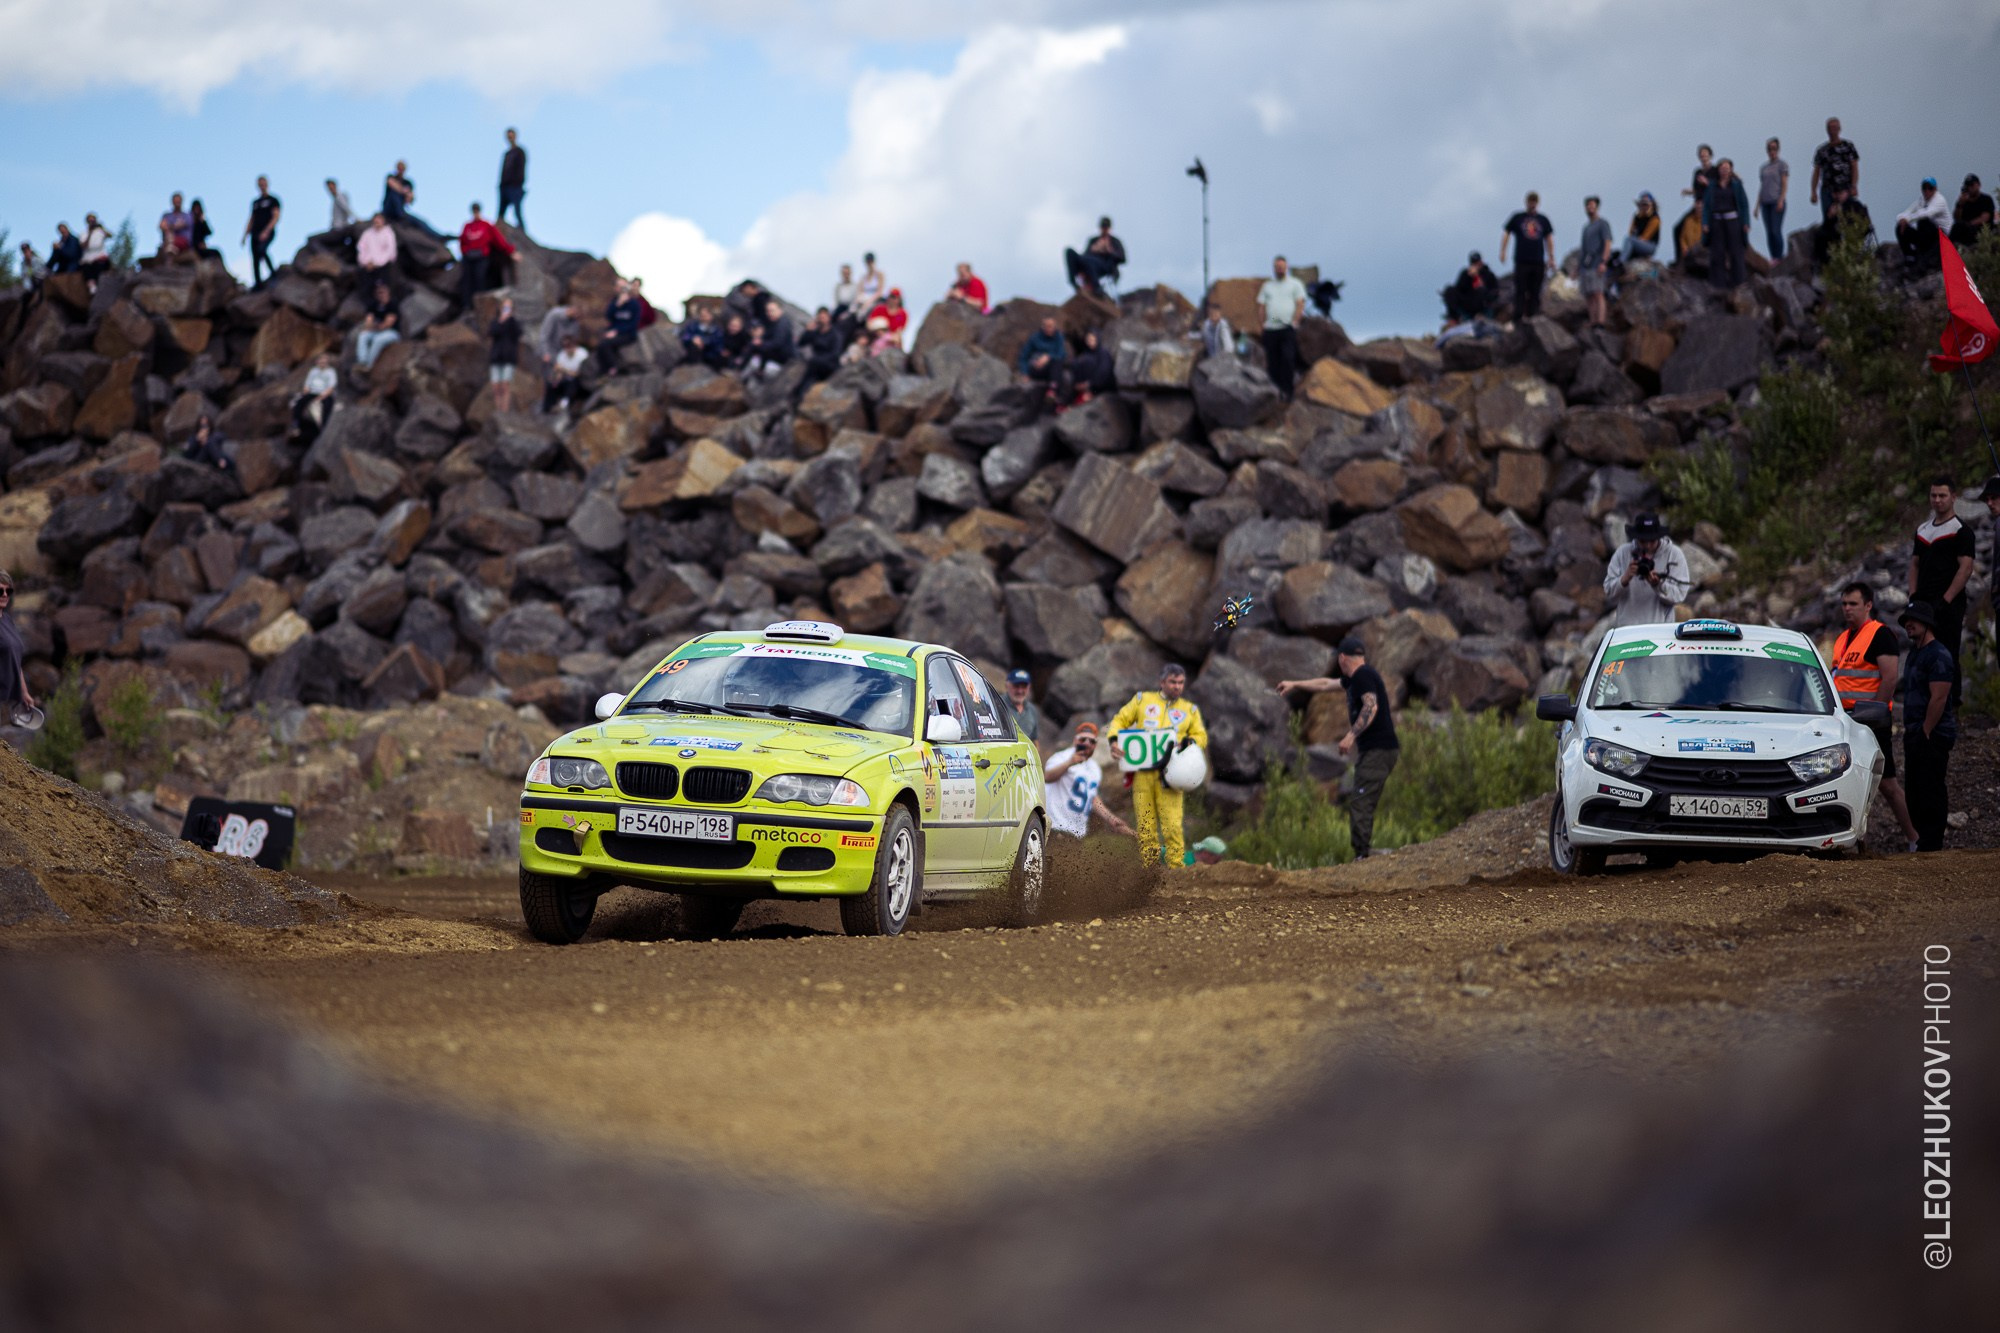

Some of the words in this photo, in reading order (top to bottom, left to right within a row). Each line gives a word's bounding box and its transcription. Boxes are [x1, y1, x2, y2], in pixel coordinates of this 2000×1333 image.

[766, 648, 853, 660] ТАТНЕФТЬ
[656, 659, 689, 675] 49
[1603, 660, 1625, 676] 41
[1123, 733, 1170, 766] OK
[993, 756, 1014, 797] RACING
[1609, 787, 1640, 800] YOKOHAMA
[1807, 792, 1836, 804] YOKOHAMA
[1746, 800, 1763, 812] 59
[700, 817, 728, 832] 198
[751, 829, 821, 844] metaco
[841, 835, 875, 848] PIRELLI
